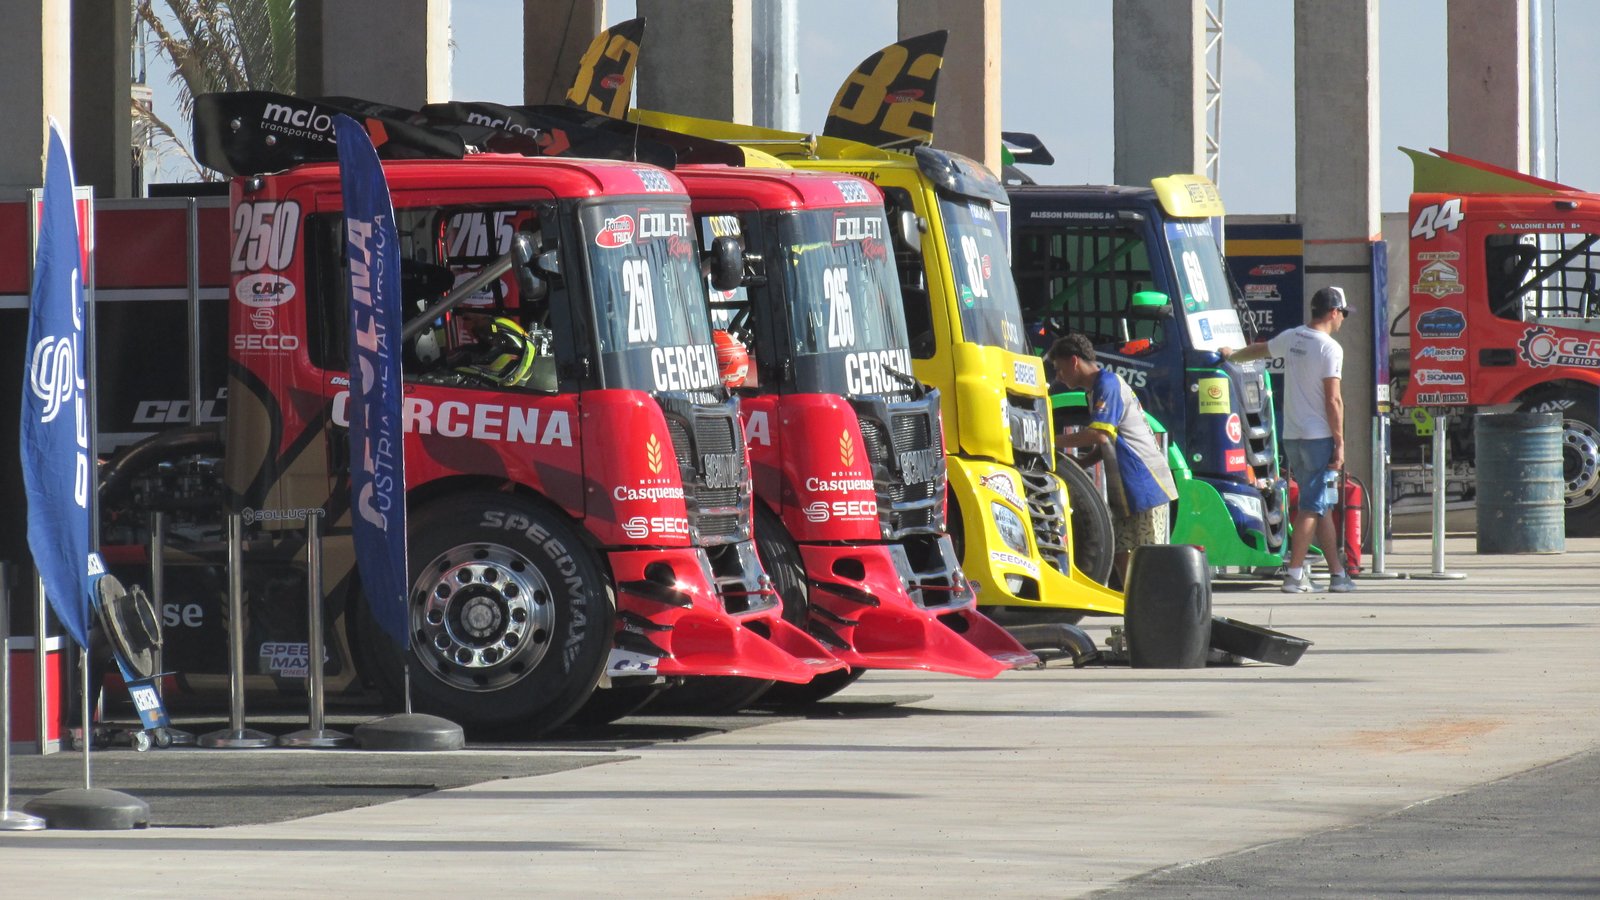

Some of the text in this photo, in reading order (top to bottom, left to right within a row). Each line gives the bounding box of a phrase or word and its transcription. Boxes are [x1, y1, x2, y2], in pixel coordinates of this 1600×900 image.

[828, 45, 943, 142] 82
[260, 121, 323, 142] transportes
[1030, 211, 1062, 219] ALISSON
[1063, 211, 1104, 219] NURNBERG
[1411, 198, 1465, 241] 44
[231, 201, 300, 272] 250
[252, 282, 290, 295] CAR
[622, 259, 658, 344] 250
[823, 268, 855, 348] 265
[234, 334, 299, 350] SECO
[1421, 347, 1465, 357] Maestro
[1561, 356, 1598, 366] FREIOS
[332, 390, 573, 447] CRCENA
[704, 453, 741, 489] SCANIA
[613, 485, 684, 502] Casquense
[832, 501, 878, 516] SECO
[651, 517, 689, 534] SECO
[261, 644, 310, 656] SPEE
